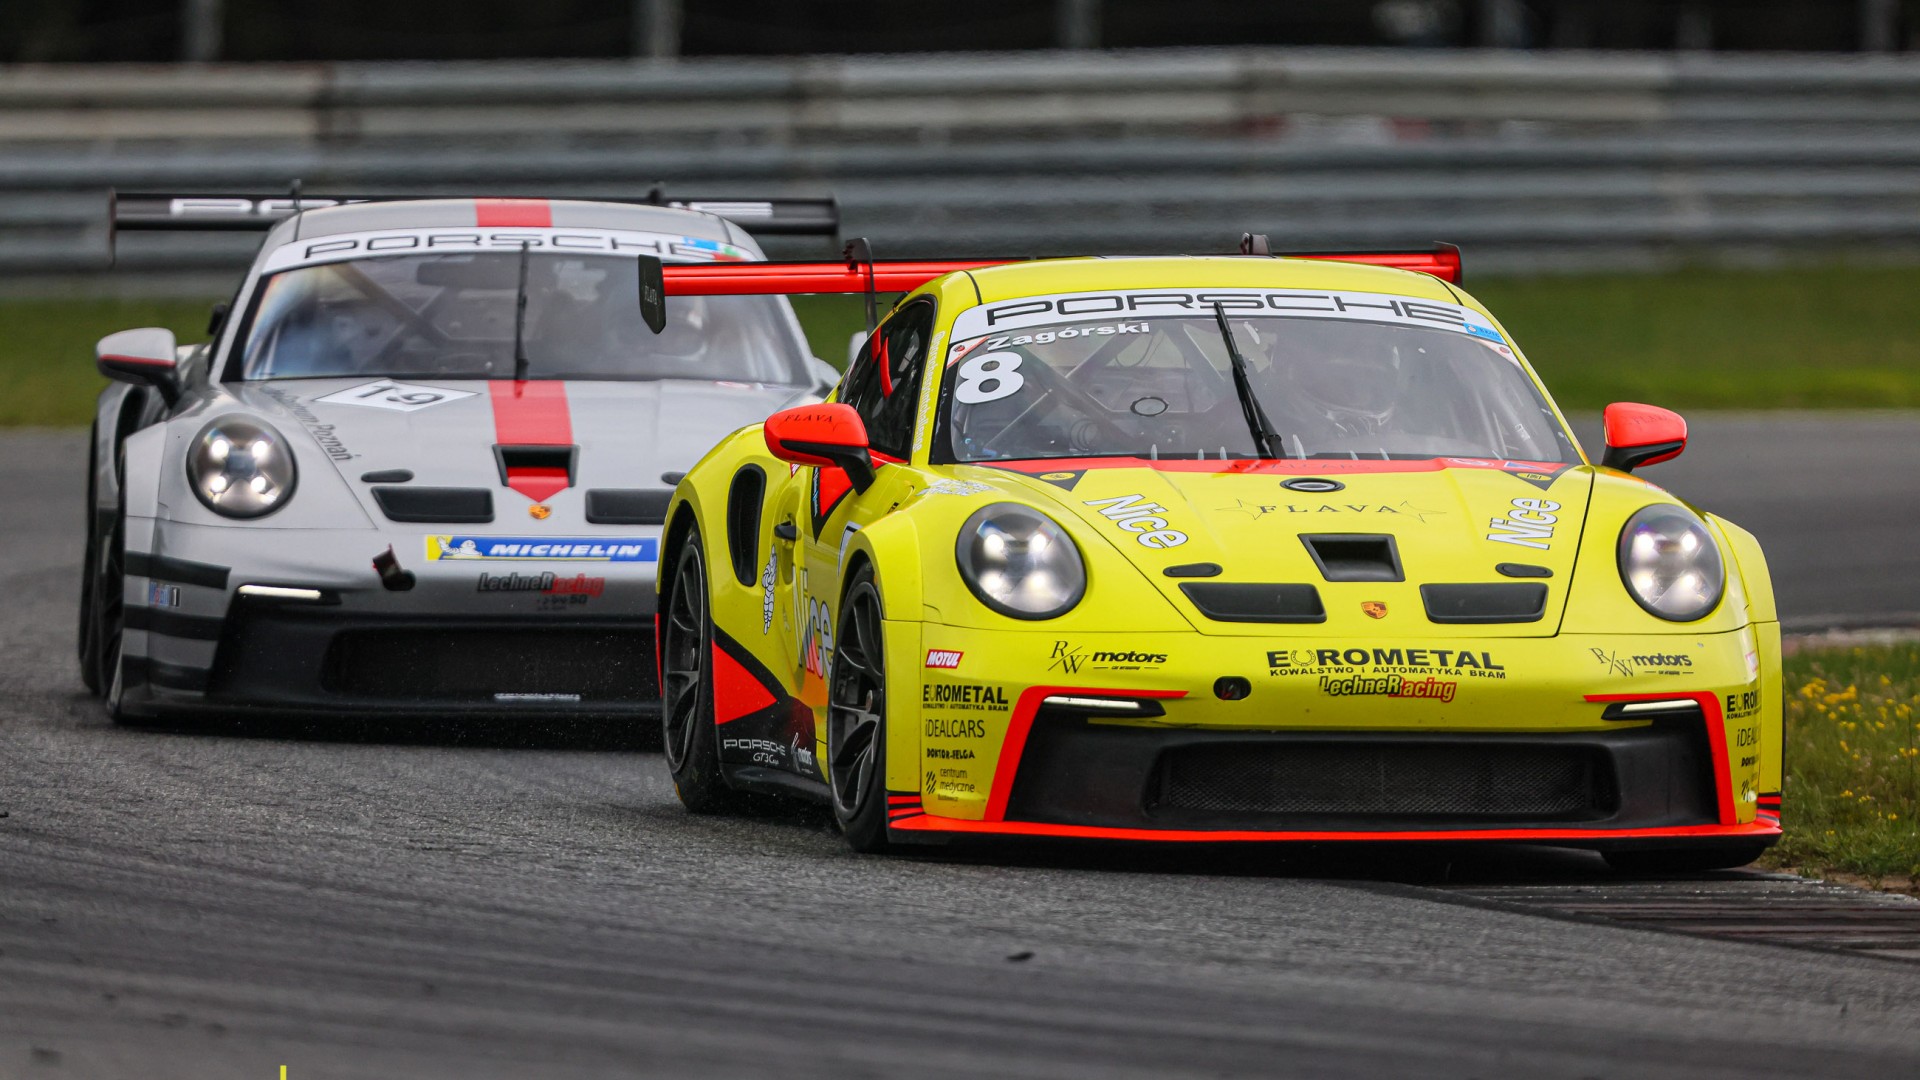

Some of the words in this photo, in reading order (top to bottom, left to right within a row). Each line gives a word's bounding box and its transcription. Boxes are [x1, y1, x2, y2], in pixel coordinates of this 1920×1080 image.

[304, 233, 714, 260] PORSCHE
[987, 293, 1466, 327] PORSCHE
[987, 322, 1150, 352] Zagórski
[955, 352, 1024, 404] 8
[784, 414, 834, 423] FLAVA
[1257, 505, 1400, 514] FLAVA
[1082, 494, 1189, 549] Nice
[1487, 497, 1561, 550] Nice
[489, 544, 643, 557] MICHELIN
[926, 651, 961, 667] MOTUL
[1091, 651, 1168, 664] motors
[1632, 652, 1692, 667] motors
[1269, 666, 1354, 677] KOWALSTWO
[1372, 666, 1462, 676] AUTOMATYKA
[1469, 669, 1506, 679] BRAM
[925, 718, 986, 738] iDEALCARS
[723, 739, 786, 756] PORSCHE
[940, 767, 968, 779] centrum
